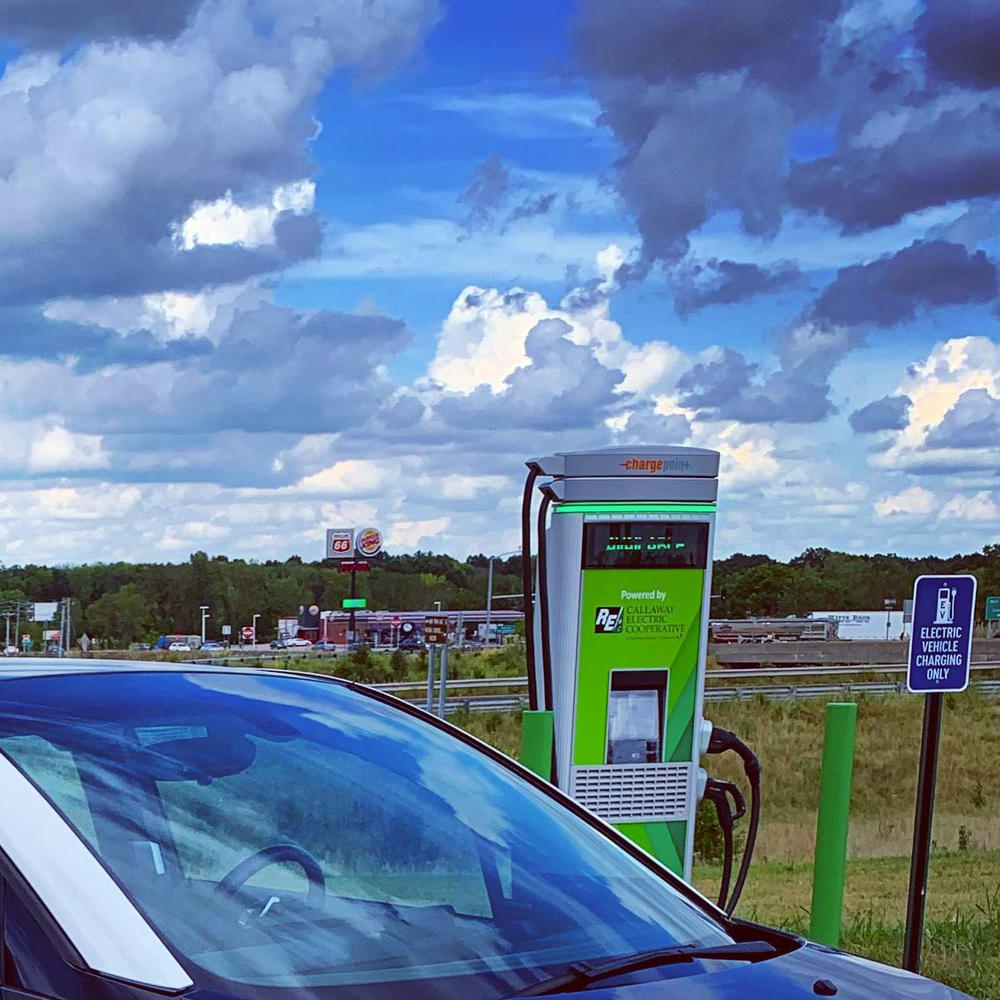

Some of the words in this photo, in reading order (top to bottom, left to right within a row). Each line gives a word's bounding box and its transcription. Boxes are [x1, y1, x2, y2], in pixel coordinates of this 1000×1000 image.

[334, 541, 348, 550] 66
[621, 590, 655, 600] Powered
[656, 590, 666, 601] by
[626, 605, 676, 614] CALLAWAY
[626, 615, 668, 624] ELECTRIC
[625, 625, 686, 634] COOPERATIVE
[921, 627, 962, 639] ELECTRIC
[922, 640, 959, 652] VEHICLE
[916, 654, 962, 667] CHARGING
[927, 668, 949, 680] ONLY
